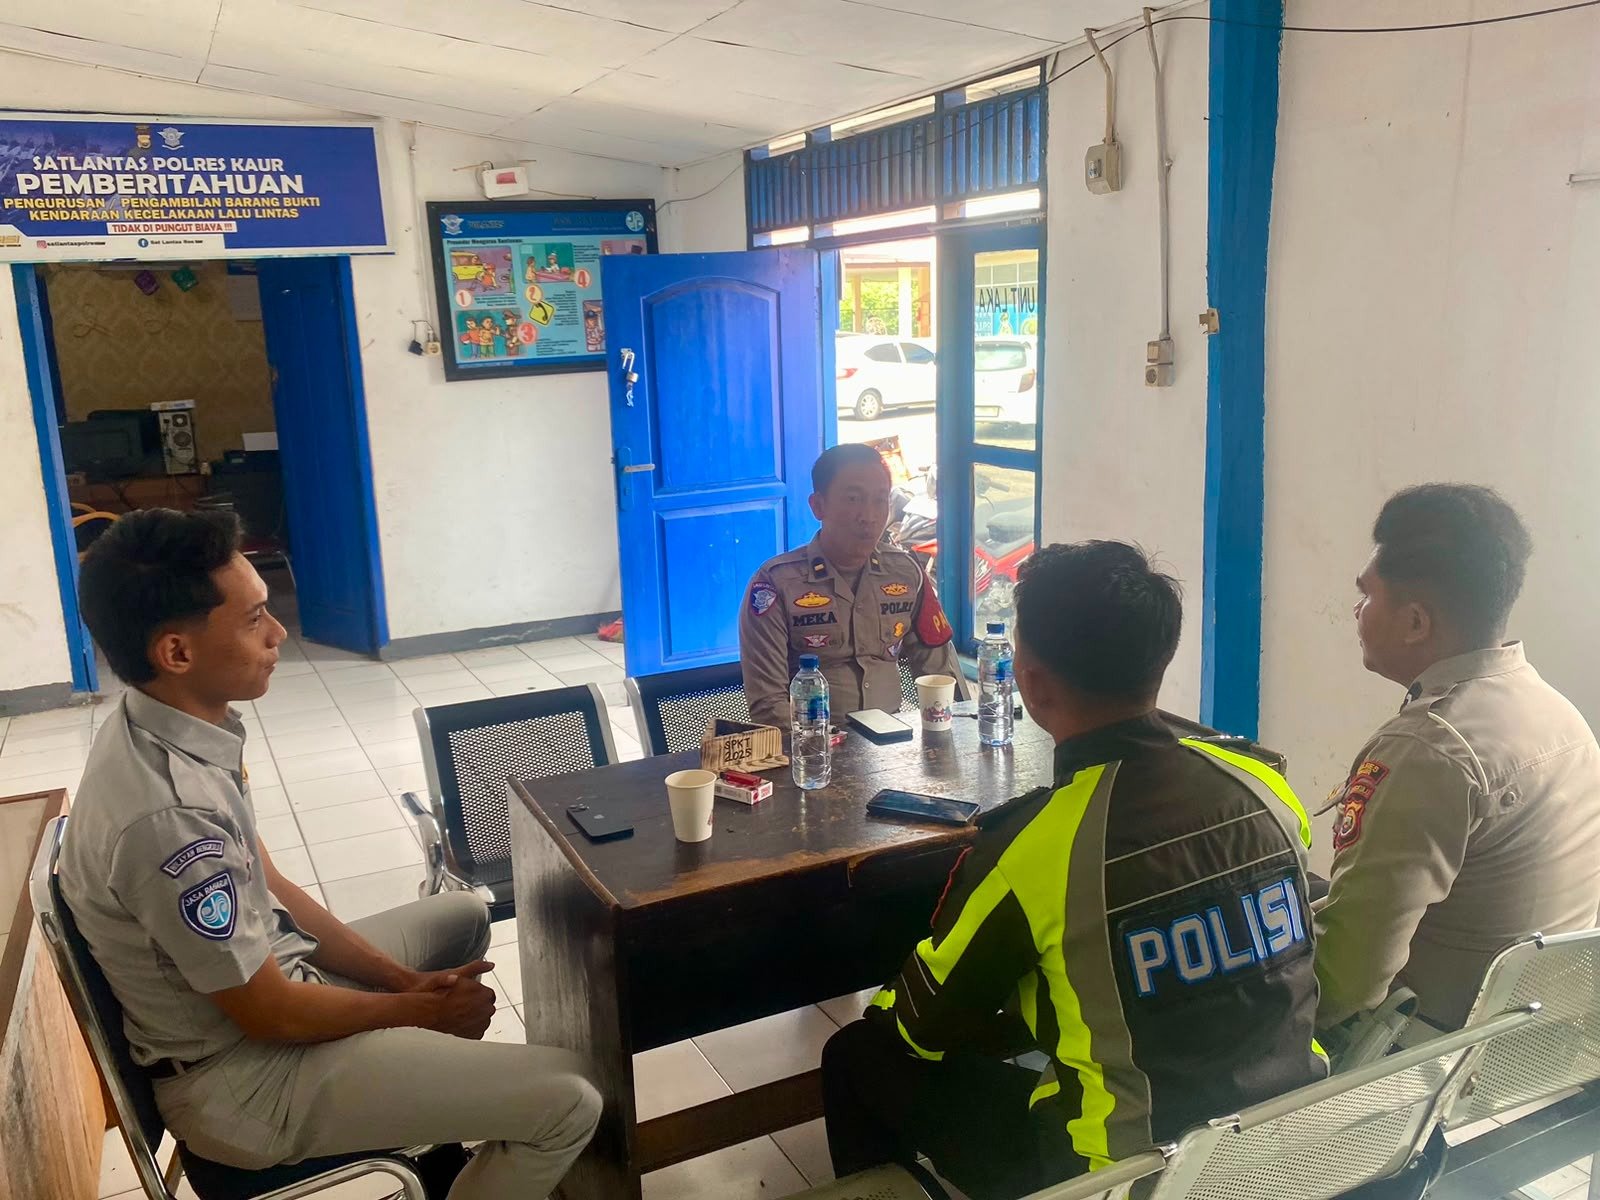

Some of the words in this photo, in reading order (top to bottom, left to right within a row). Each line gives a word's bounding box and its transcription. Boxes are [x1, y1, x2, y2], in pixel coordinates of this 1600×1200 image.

[32, 155, 148, 171] SATLANTAS
[152, 157, 226, 171] POLRES
[231, 158, 284, 172] KAUR
[16, 173, 304, 195] PEMBERITAHUAN
[4, 198, 105, 209] PENGURUSAN
[121, 198, 221, 208] PENGAMBILAN
[225, 197, 279, 207] BARANG
[283, 197, 320, 207] BUKTI
[29, 211, 119, 221] KENDARAAN
[125, 209, 214, 219] KECELAKAAN
[218, 209, 251, 219] LALU
[255, 208, 299, 218] LINTAS
[112, 224, 141, 233] TIDAK
[143, 224, 153, 232] DI
[155, 224, 193, 232] PUNGUT
[195, 223, 222, 231] BIAYA
[577, 270, 587, 287] 4
[530, 286, 536, 301] 2
[880, 602, 913, 615] POLRI
[793, 611, 837, 627] MEKA
[725, 738, 750, 749] SPKT
[724, 748, 752, 762] 2025
[186, 892, 204, 907] JASA
[1125, 877, 1305, 996] POLISI
